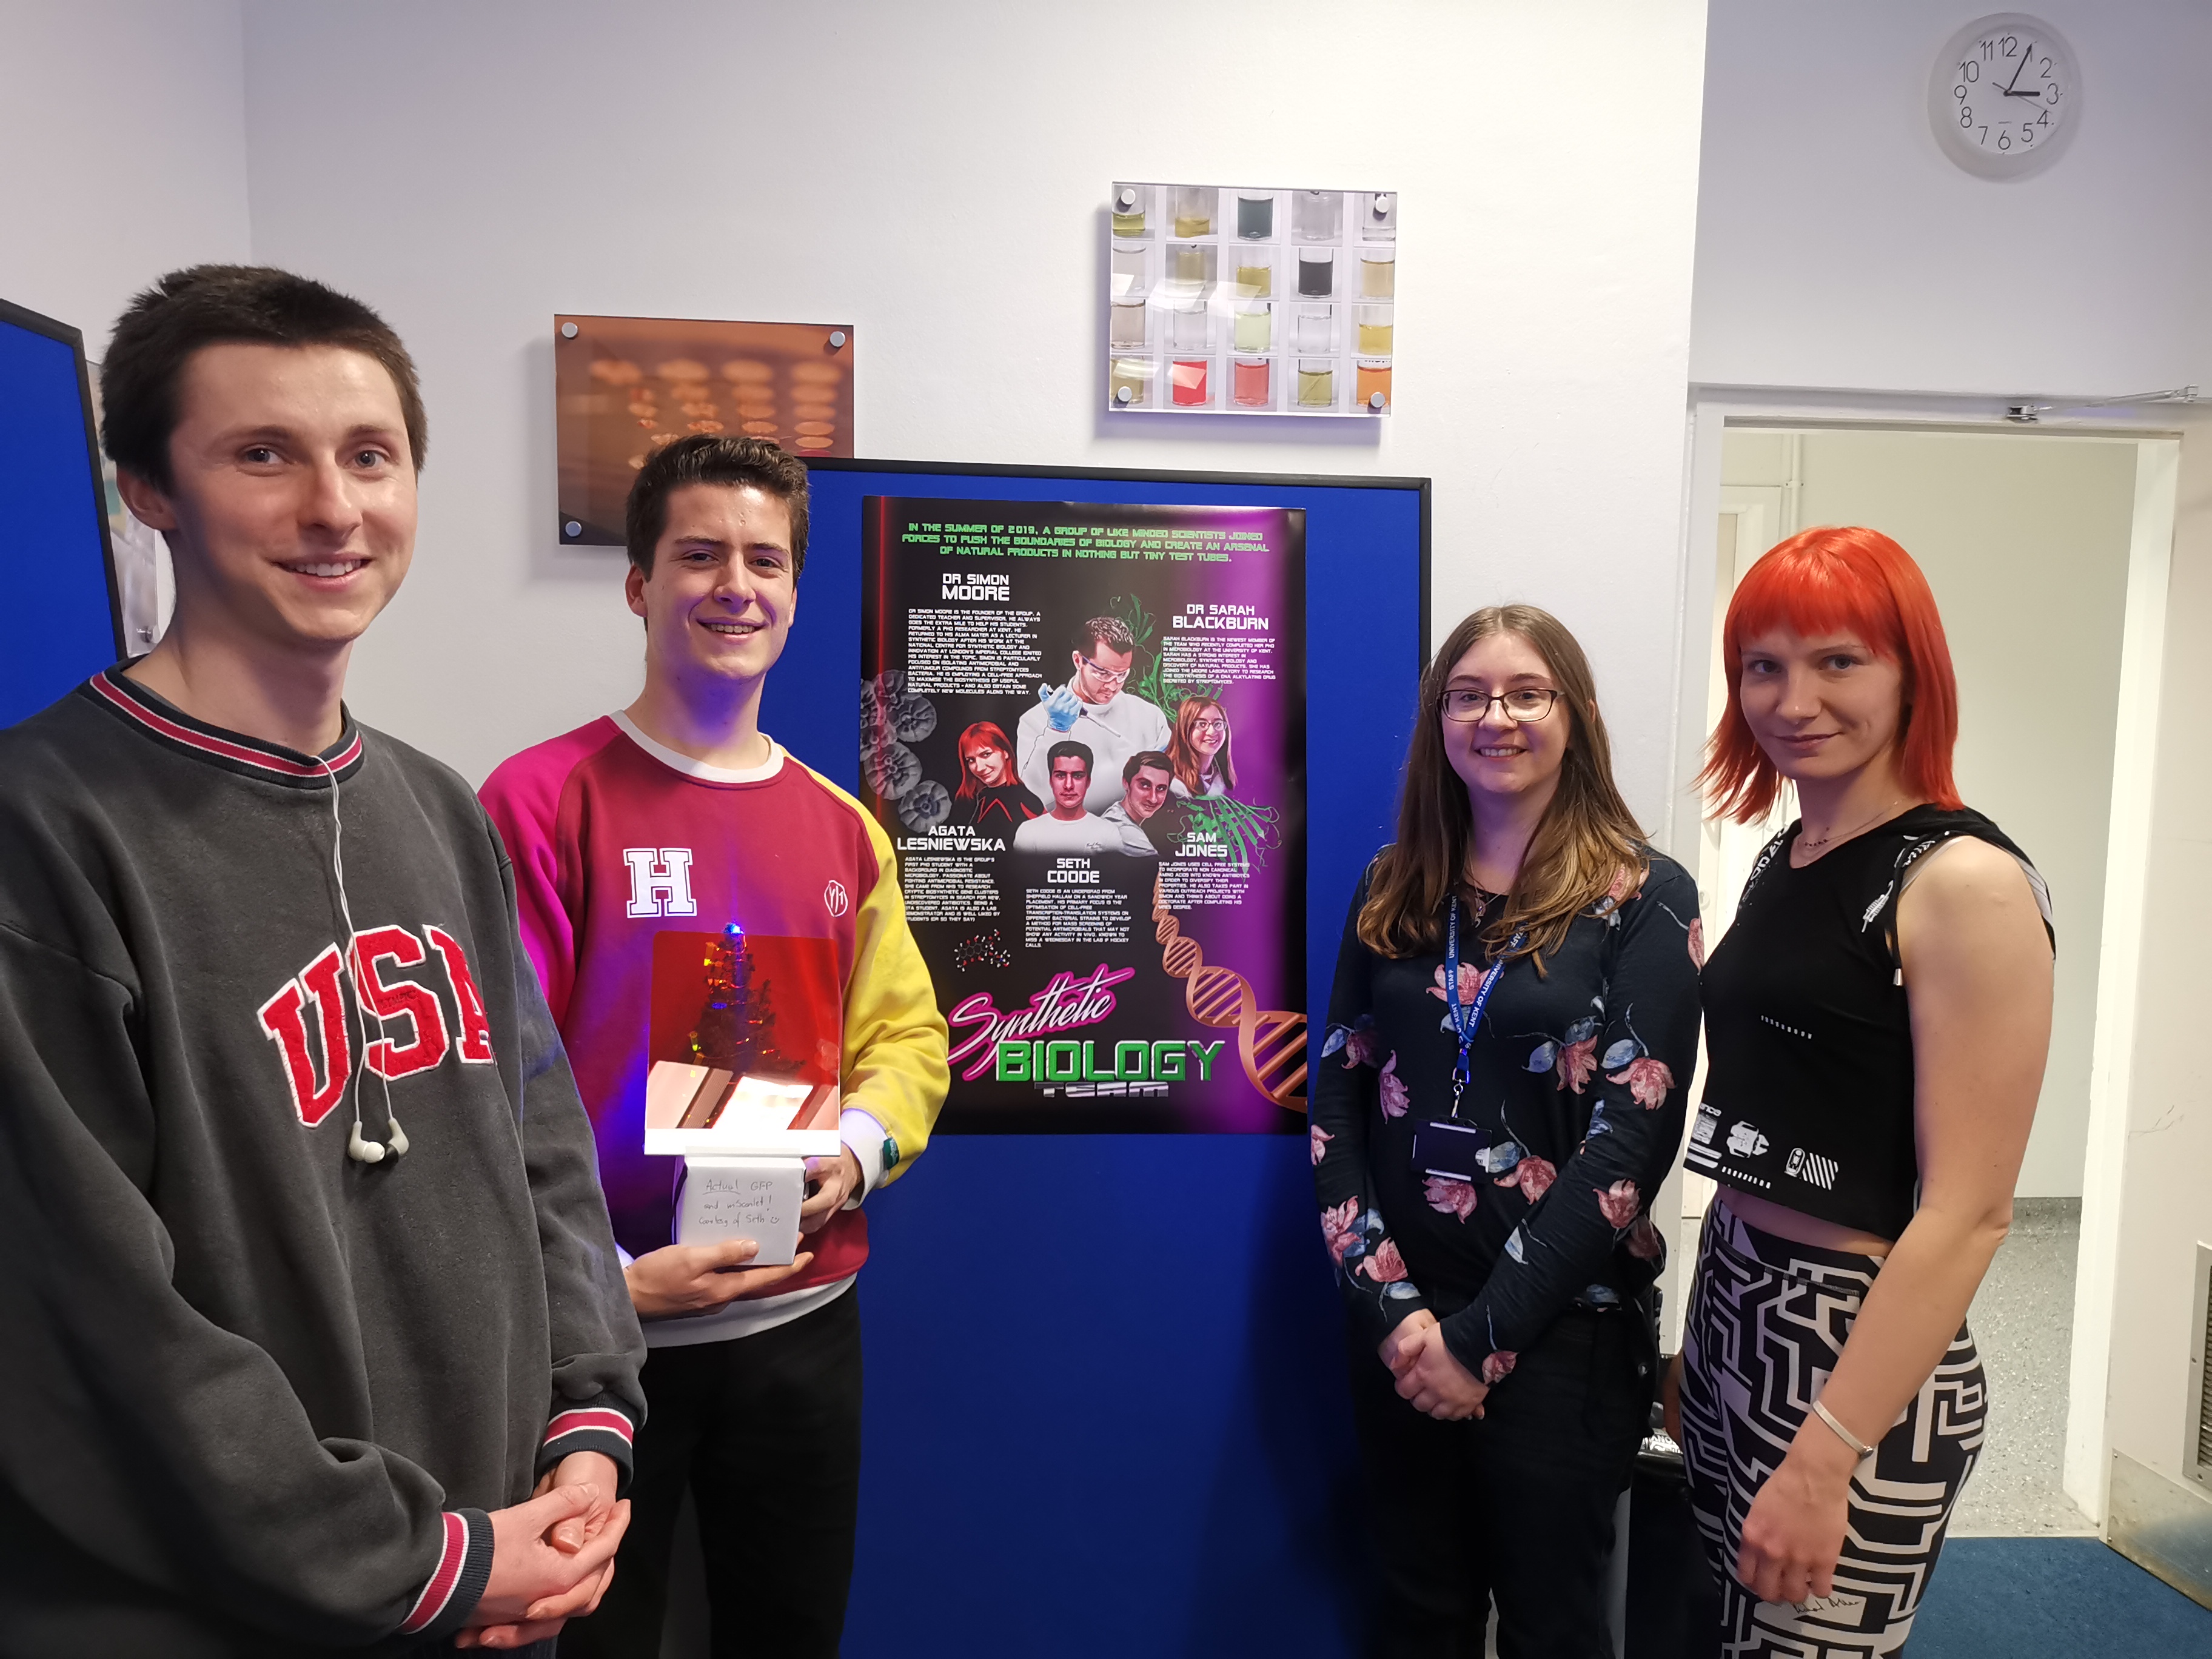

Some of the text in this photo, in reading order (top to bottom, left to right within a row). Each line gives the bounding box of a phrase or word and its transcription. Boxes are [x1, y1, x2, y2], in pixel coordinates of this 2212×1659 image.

[1980, 40, 1993, 61] 11
[1998, 36, 2017, 57] 12
[1959, 61, 1979, 83] 10
[2040, 57, 2053, 78] 2
[1954, 85, 1967, 105] 9
[2046, 82, 2059, 105] 3
[1960, 106, 1972, 128] 8
[2036, 110, 2049, 129] 4
[1978, 126, 1988, 145] 7
[1998, 130, 2011, 150] 6
[2021, 122, 2033, 142] 5
[945, 524, 987, 533] SUMMER
[1008, 525, 1038, 535] 2019,
[1043, 526, 1050, 535] A
[1054, 526, 1087, 535] GROUP
[1091, 528, 1104, 536] OF
[1107, 528, 1129, 537] LIKE
[1133, 529, 1168, 538] MINDED
[1171, 530, 1226, 540] SCIENTISTS
[1229, 531, 1262, 541] JOINED
[902, 534, 1270, 552] FORCES TO PUSH THE BOUNDARIES OF BIOLOGY AND CREATE AN ARSENAL
[957, 547, 1004, 555] NATURAL
[1008, 548, 1057, 557] PRODUCTS
[1062, 549, 1071, 558] IN
[1076, 549, 1116, 558] NOTHING
[1121, 551, 1140, 559] BUT
[1144, 552, 1165, 560] TINY
[1169, 552, 1194, 561] TEST
[1197, 553, 1232, 562] TUBES.
[943, 574, 1009, 586] DR SIMON
[942, 586, 1010, 601] MOORE
[1187, 604, 1255, 615] DR SARAH
[1173, 616, 1269, 630] BLACKBURN
[928, 826, 976, 836] AGATA
[1187, 832, 1216, 843] SAM
[897, 837, 1005, 851] LESNIEWSKA
[1175, 844, 1227, 857] JONES
[1056, 858, 1090, 868] SETH
[623, 848, 697, 918] H
[1047, 871, 1100, 883] COODE
[1510, 931, 1524, 947] TAFF
[1476, 996, 1484, 1007] OF
[947, 965, 1132, 1078] Synthetic
[1452, 1003, 1460, 1023] KENT
[1469, 1007, 1480, 1027] KENT
[996, 1040, 1225, 1082] BIOLOGY
[1034, 1082, 1169, 1098] TEAM
[706, 1179, 773, 1191] Actual GFP
[704, 1201, 719, 1209] and
[732, 1212, 741, 1228] of
